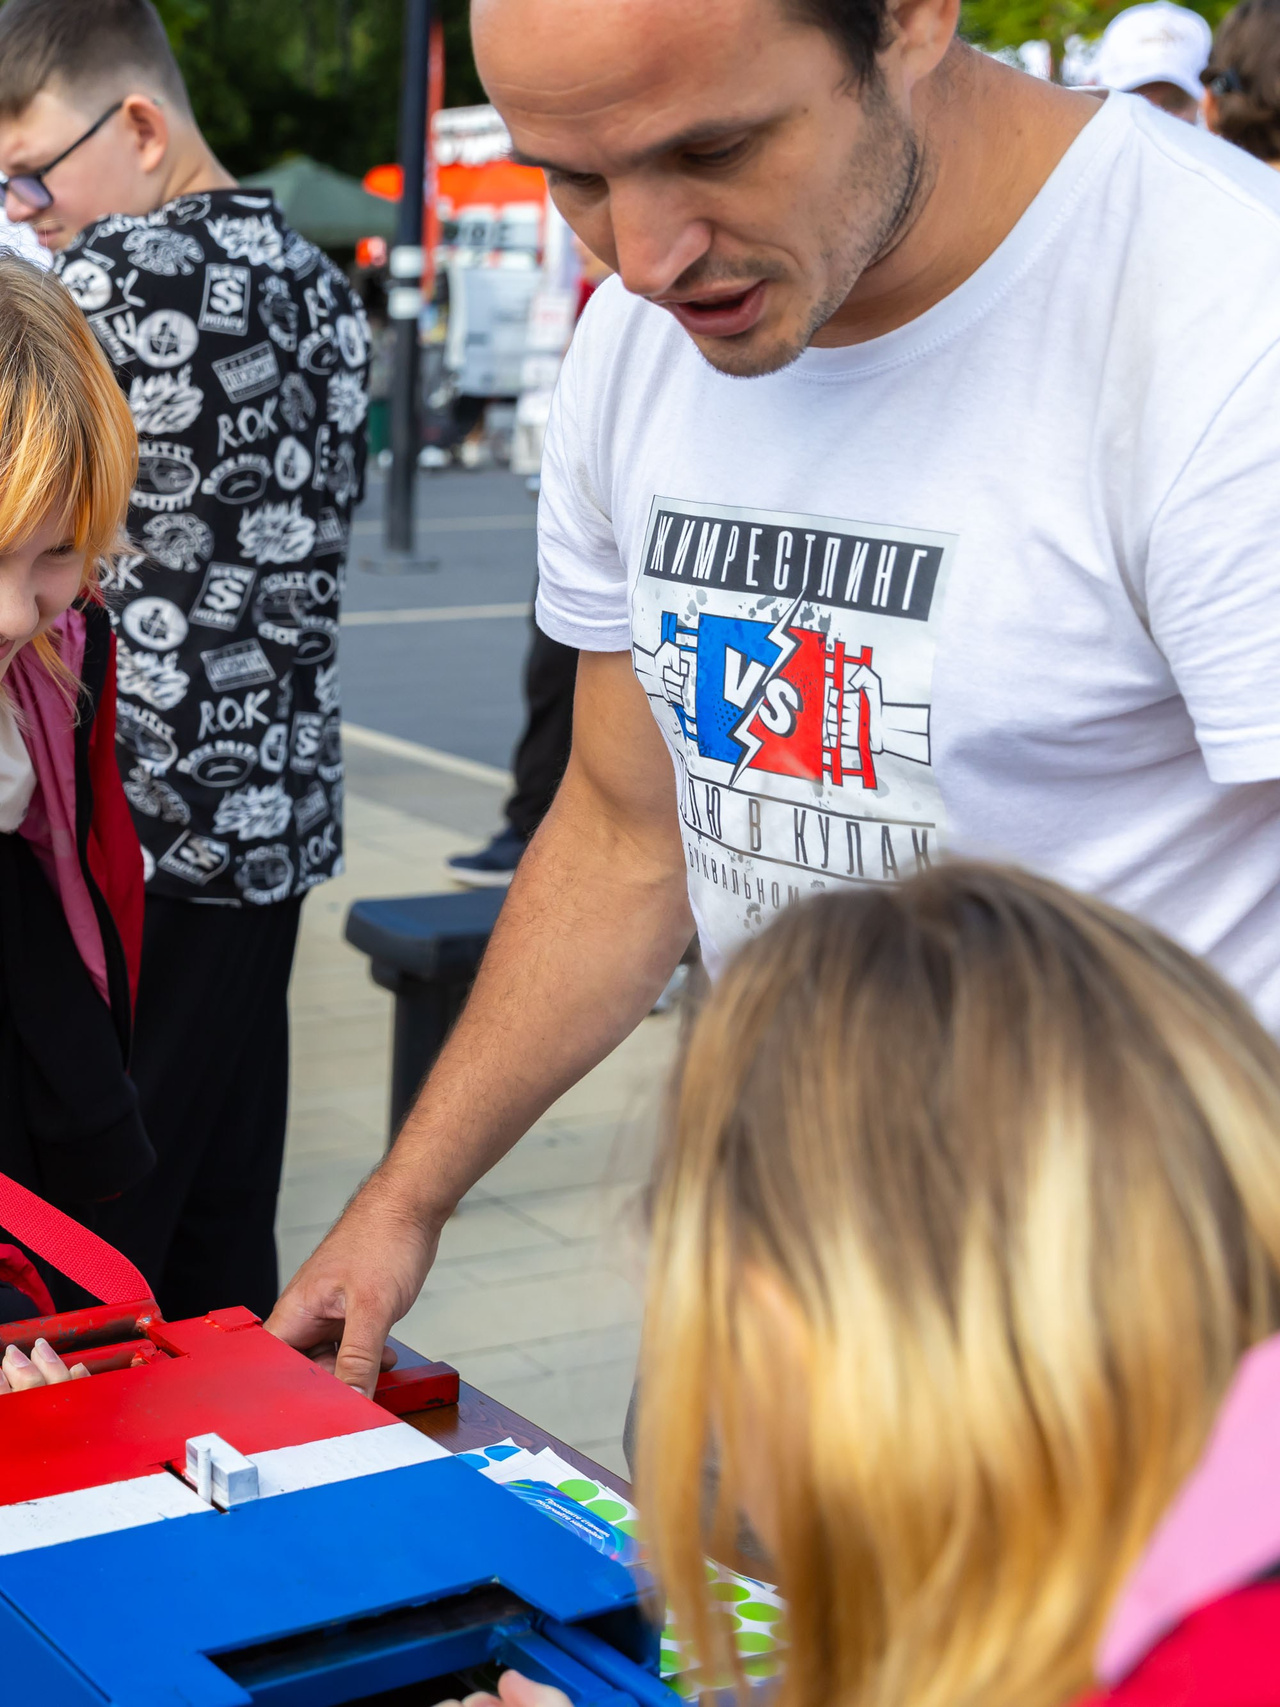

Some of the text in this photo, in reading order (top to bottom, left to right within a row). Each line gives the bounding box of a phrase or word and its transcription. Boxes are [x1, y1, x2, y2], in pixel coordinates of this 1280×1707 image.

[650, 515, 928, 611] ЖИМРЕСТЛИНГ
[722, 644, 801, 736] VS
[681, 758, 934, 879] ЛЮ В КУЛАК
